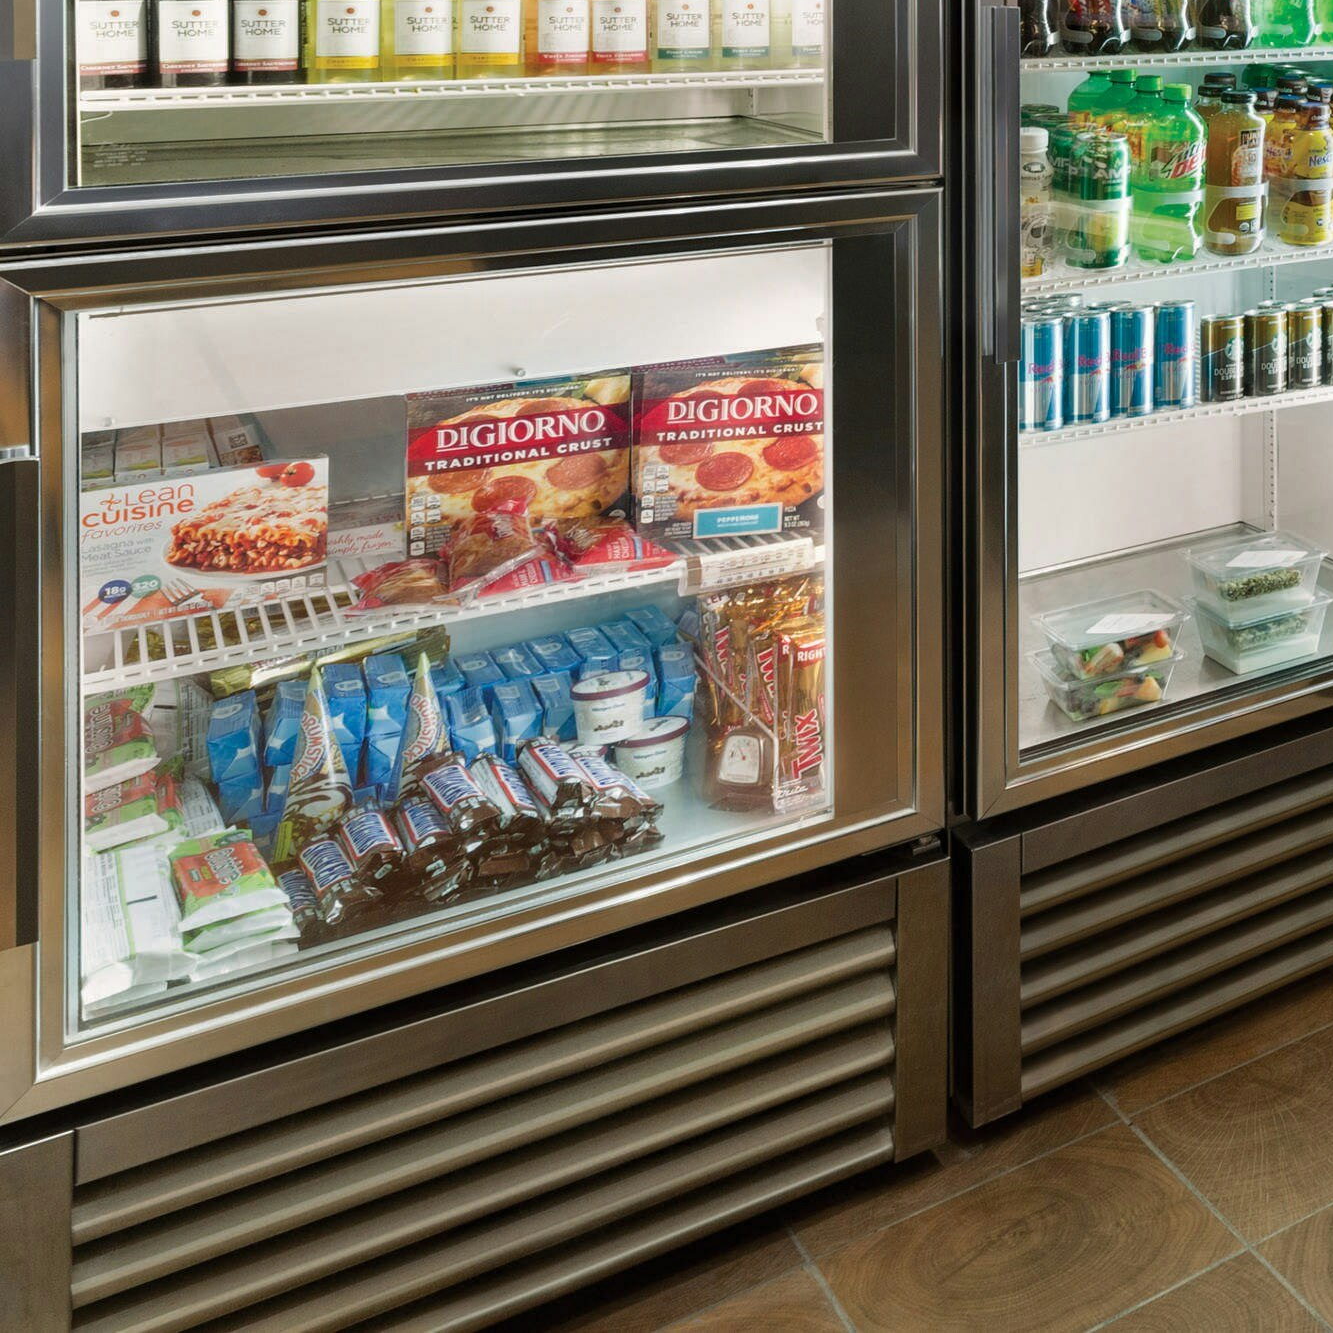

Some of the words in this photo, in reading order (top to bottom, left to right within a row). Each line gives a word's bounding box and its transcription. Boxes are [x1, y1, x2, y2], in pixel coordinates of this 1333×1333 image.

[656, 426, 767, 442] TRADITIONAL
[773, 420, 823, 434] CRUST
[424, 448, 550, 472] TRADITIONAL
[556, 436, 613, 454] CRUST
[124, 483, 195, 508] Lean
[791, 708, 825, 779] TWIX
